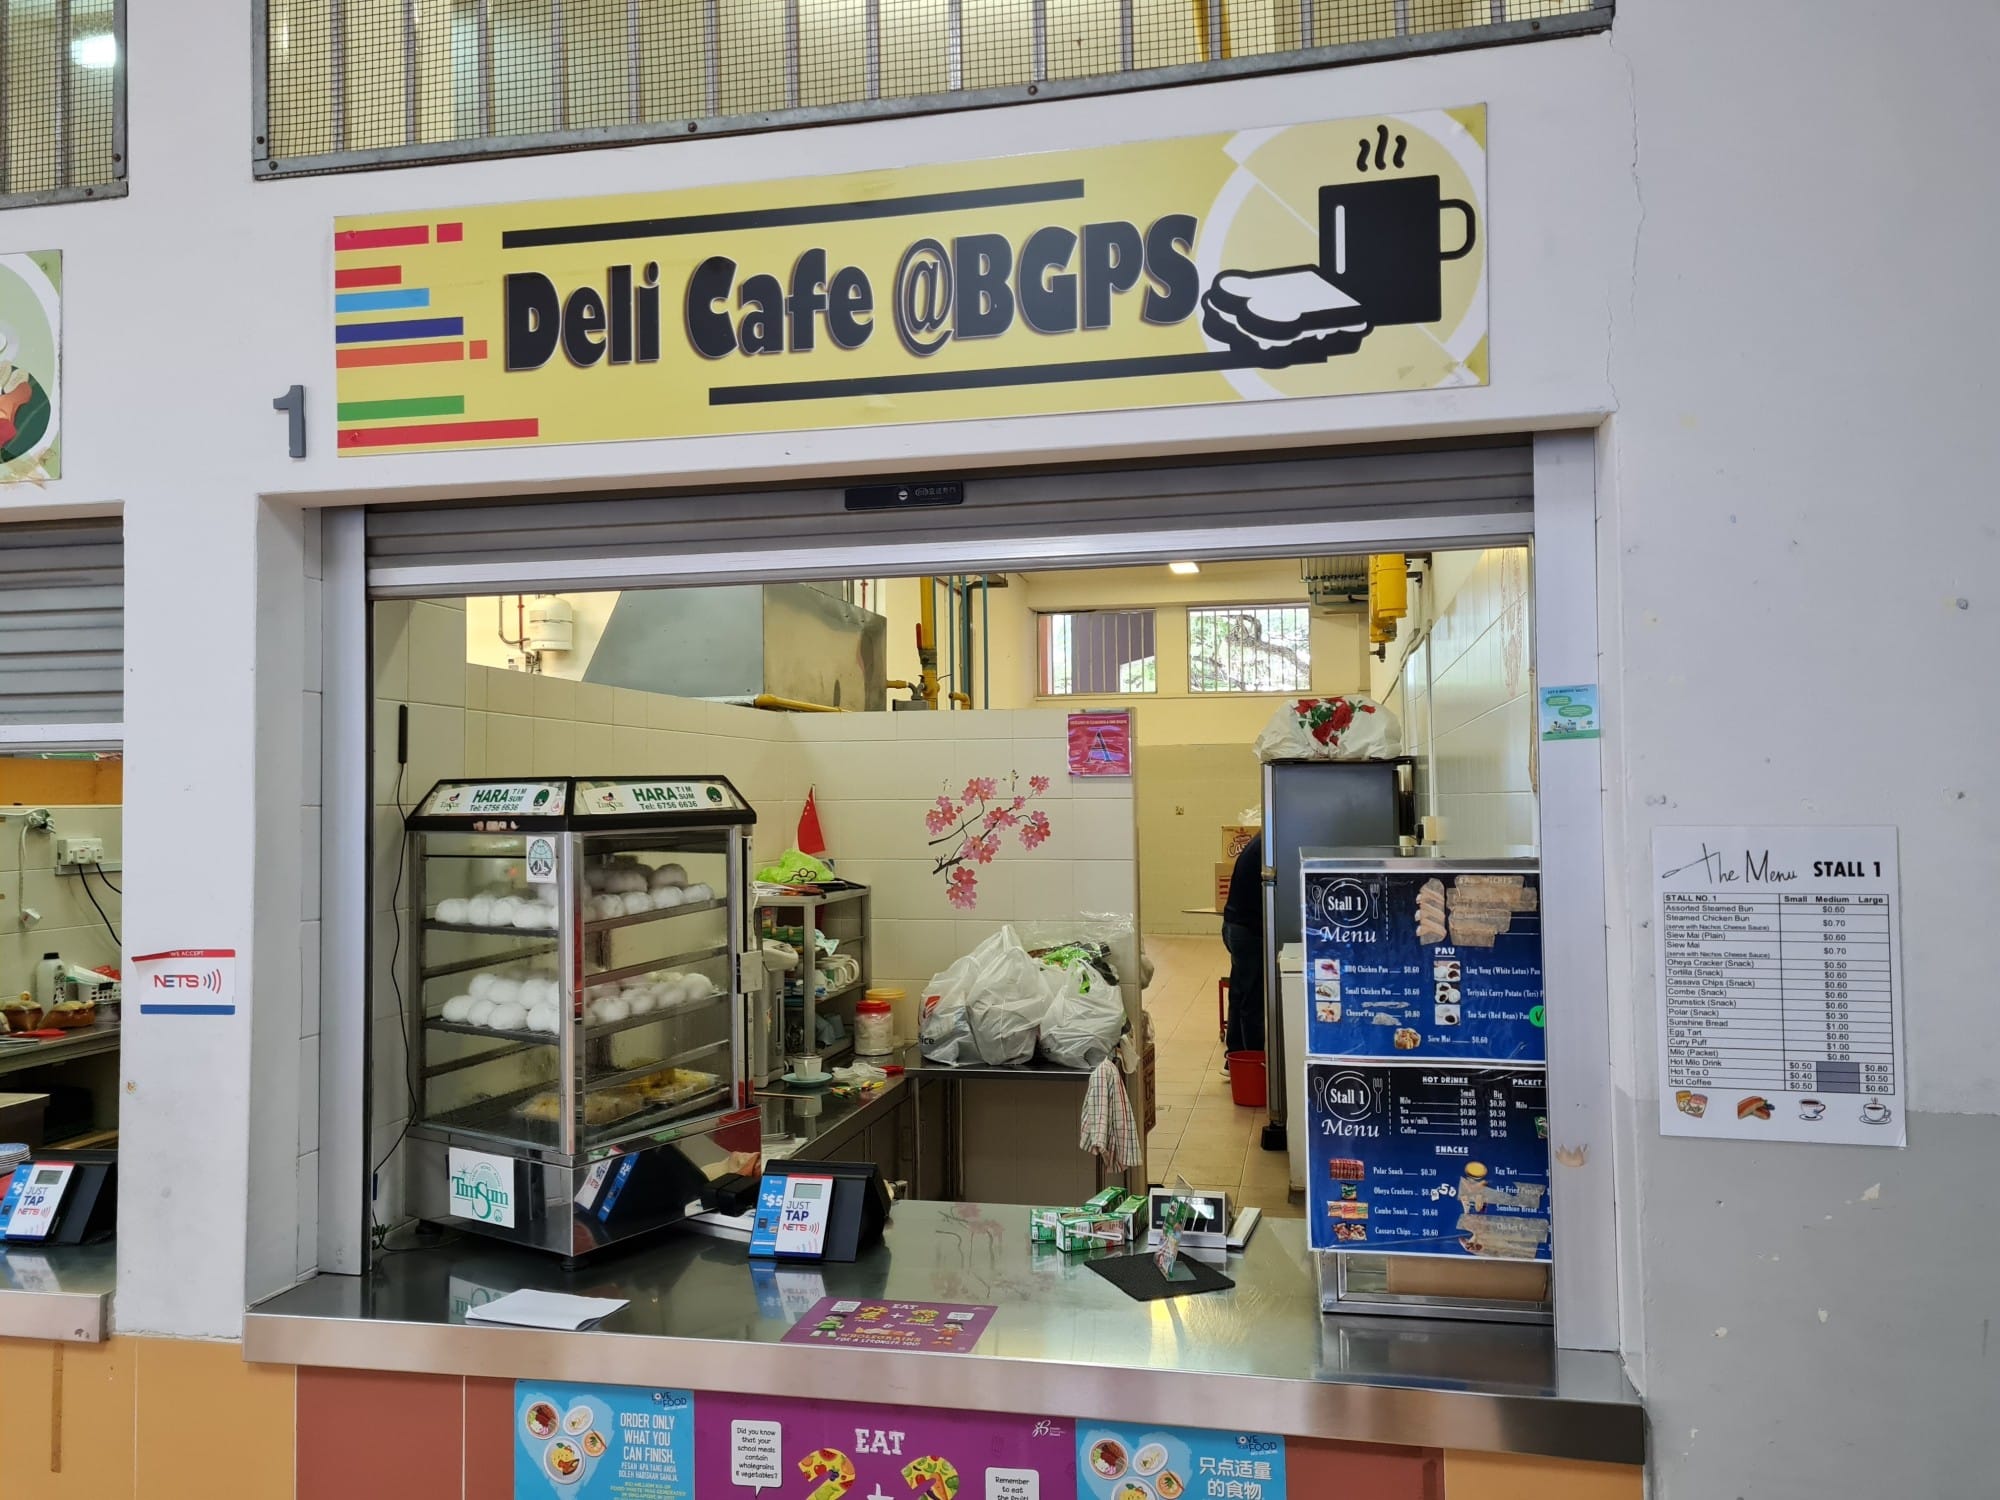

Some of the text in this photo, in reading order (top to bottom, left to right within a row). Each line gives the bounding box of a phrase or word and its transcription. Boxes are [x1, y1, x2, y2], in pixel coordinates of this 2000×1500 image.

[505, 213, 1199, 371] Deli Cafe @BGPS
[273, 385, 306, 458] 1
[472, 789, 509, 802] HARA
[632, 787, 678, 801] HARA
[1662, 842, 1880, 884] The Menu STALL 1
[1328, 896, 1361, 910] Stall 1
[1859, 896, 1883, 905] Large
[1321, 926, 1377, 943] Menu
[1701, 932, 1725, 940] (Plain)
[1435, 947, 1455, 955] PAU
[1725, 959, 1754, 968] (Snack)
[1694, 969, 1723, 977] (Snack)
[154, 975, 199, 988] NETS
[1702, 979, 1724, 987] Chips
[1726, 980, 1755, 988] (Snack)
[1698, 989, 1727, 997] (Snack)
[1708, 999, 1736, 1008] (Snack)
[1690, 1009, 1719, 1018] (Snack)
[1670, 1029, 1684, 1037] Egg
[1670, 1038, 1689, 1047] Curry
[1687, 1049, 1718, 1057] (Packet)
[1789, 1072, 1812, 1080] $0.40
[1330, 1088, 1364, 1104] Stall 1
[1321, 1119, 1380, 1137] Menu
[1436, 1146, 1468, 1154] SNACKS
[26, 1187, 48, 1195] JUST
[24, 1196, 44, 1206] TAP
[786, 1201, 811, 1209] JUST
[18, 1208, 40, 1216] NETS
[785, 1210, 809, 1221] TAP
[783, 1223, 807, 1231] NETS
[652, 1392, 670, 1401] LOVE
[663, 1398, 687, 1407] FOOD
[620, 1412, 675, 1430] ORDER ONLY
[624, 1429, 670, 1446] WHAT YOU
[855, 1428, 905, 1455] EAT
[1235, 1435, 1258, 1445] LOVE
[1249, 1442, 1277, 1452] FOOD
[624, 1446, 675, 1464] CAN FINISH.
[1200, 1457, 1272, 1480] 只点适量
[995, 1476, 1030, 1485] Remember
